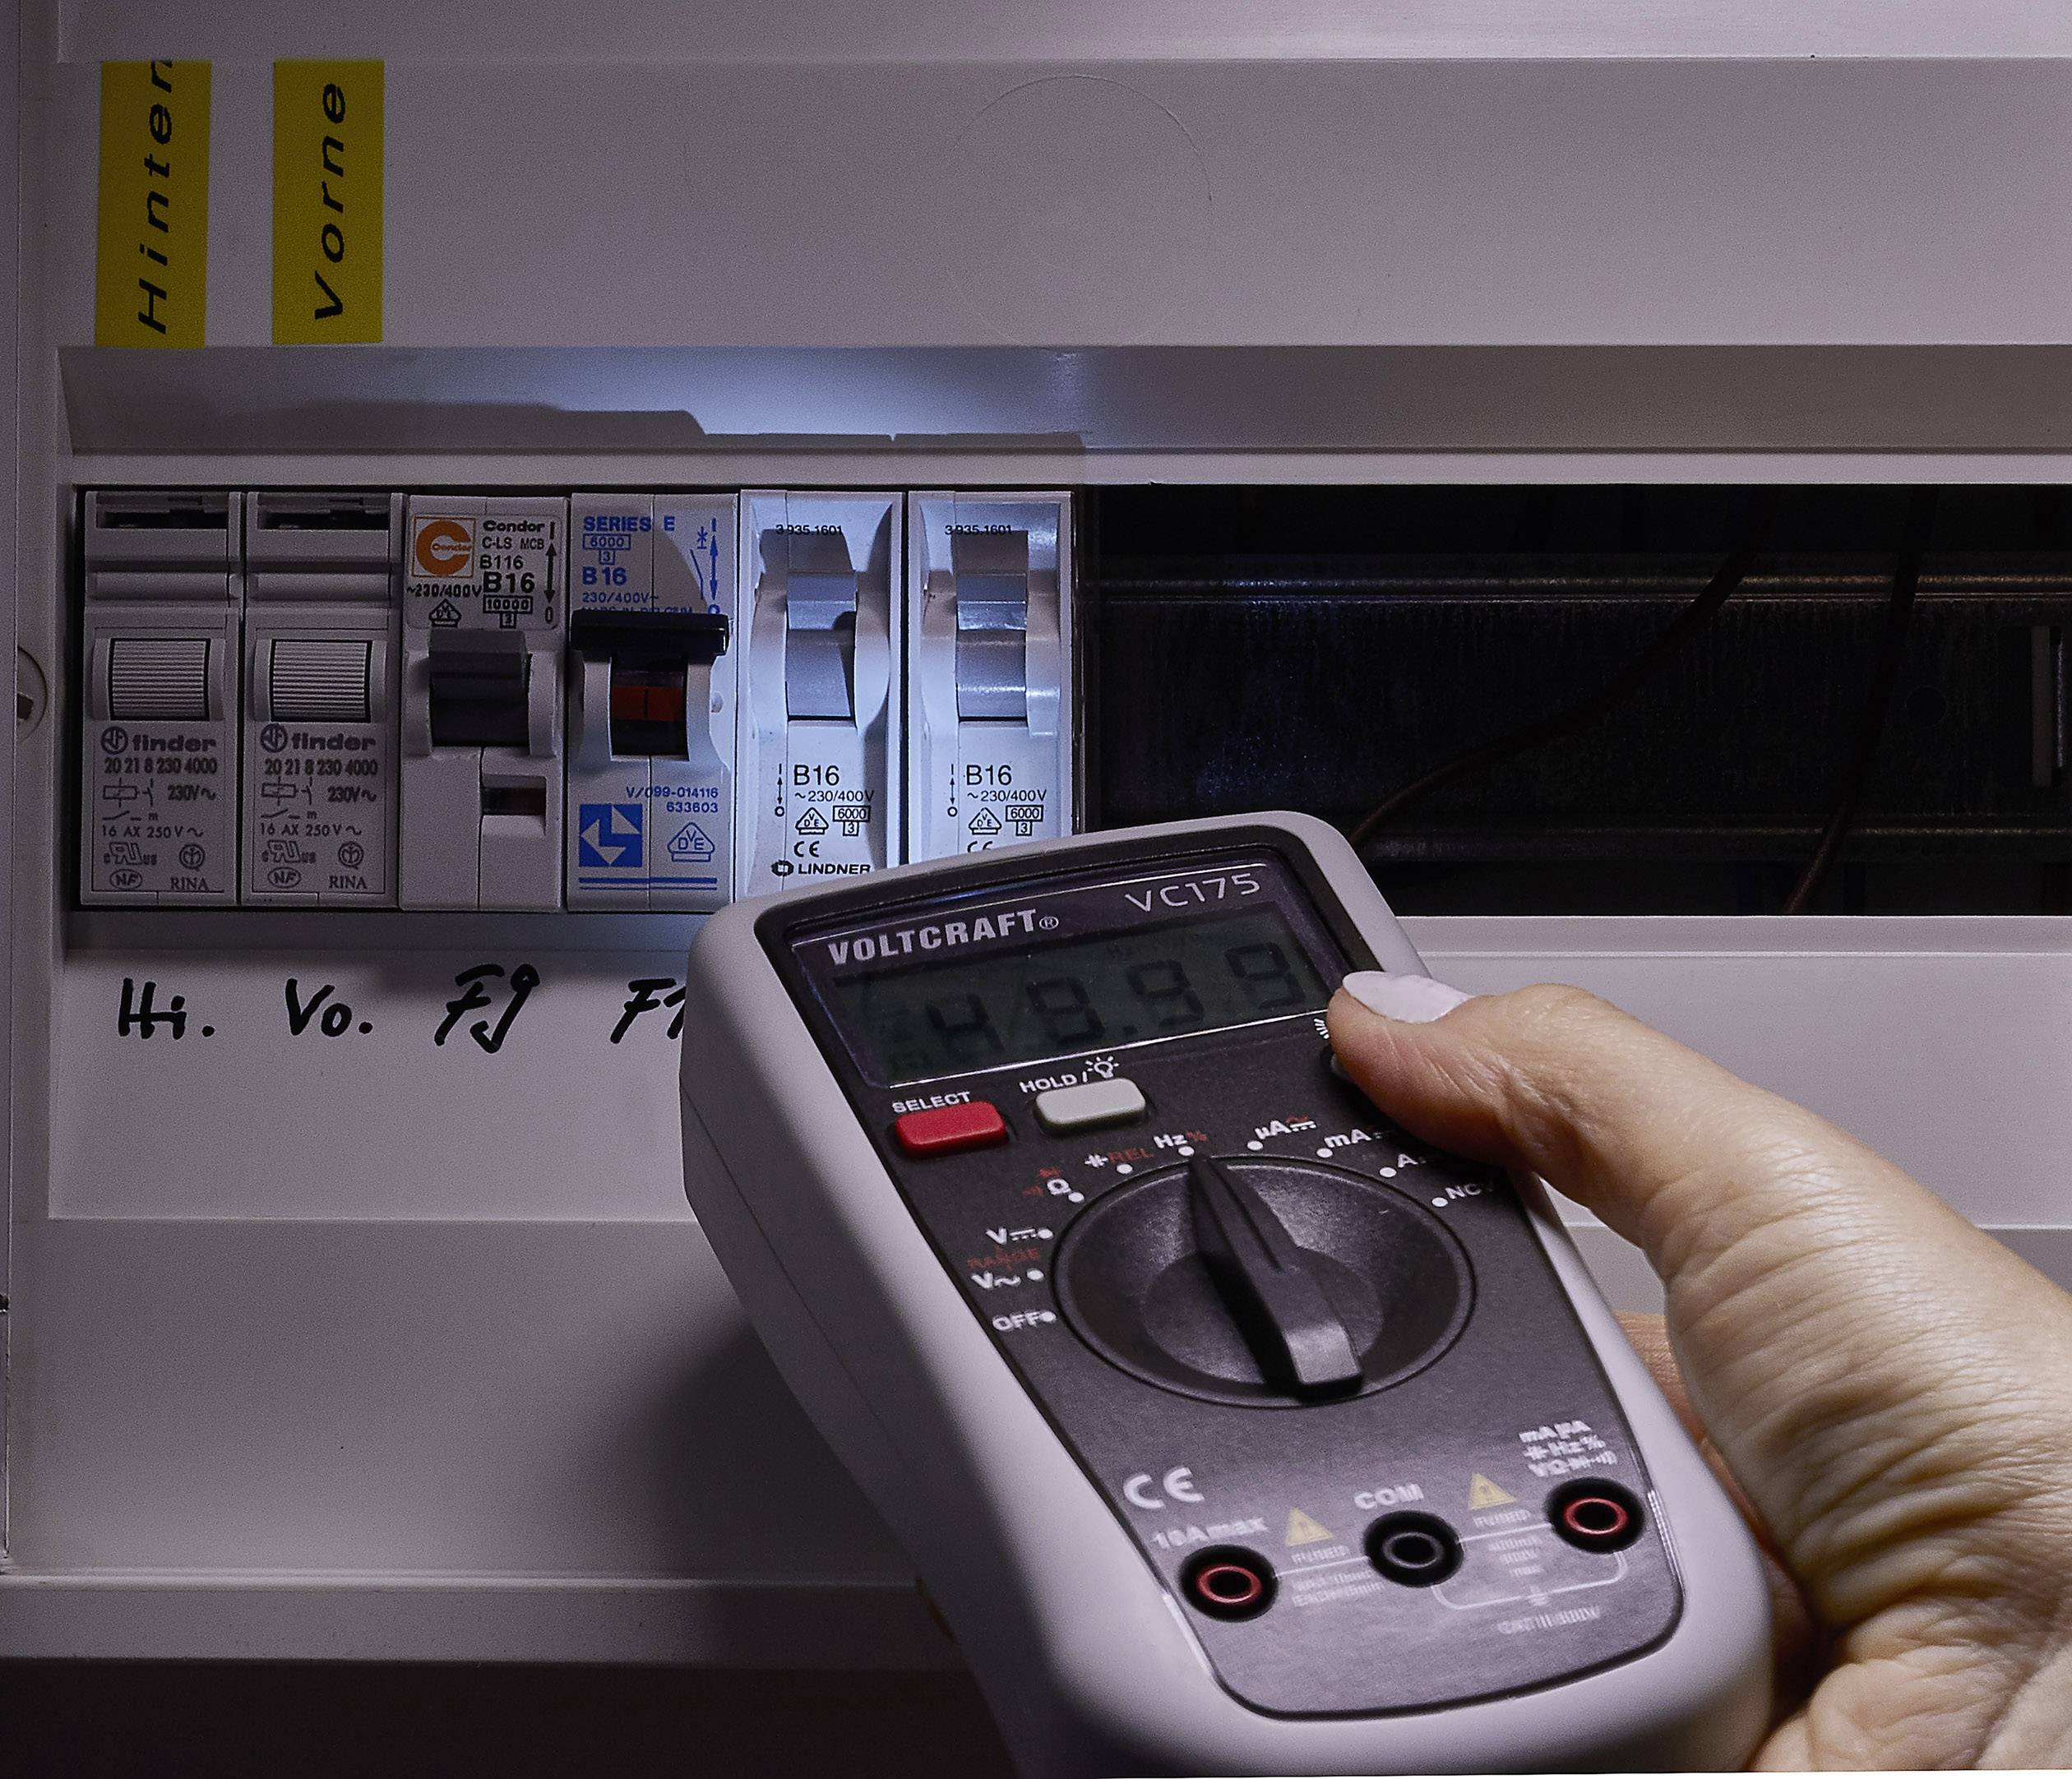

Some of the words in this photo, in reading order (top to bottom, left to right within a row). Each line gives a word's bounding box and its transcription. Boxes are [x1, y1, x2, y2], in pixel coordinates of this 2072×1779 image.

[314, 83, 345, 320] Vorne
[483, 520, 545, 533] Condor
[583, 515, 652, 532] SERIES
[664, 515, 675, 531] E
[520, 538, 545, 550] MCB
[589, 535, 625, 548] 6000
[480, 555, 524, 570] B116
[483, 571, 536, 594] B16
[485, 599, 530, 610] 10000
[132, 734, 217, 753] finder
[292, 732, 377, 751] finder
[793, 765, 839, 786] B16
[965, 765, 1012, 786] B16
[666, 802, 719, 813] 633603
[837, 807, 867, 820] 6000
[1011, 806, 1040, 820] 6000
[102, 825, 117, 837] 16
[146, 826, 172, 839] 250
[261, 824, 275, 835] 16
[306, 825, 330, 837] 250
[847, 823, 855, 834] 3
[1020, 822, 1029, 834] 3
[793, 840, 821, 857] CE
[798, 863, 872, 875] LINDNER
[115, 872, 140, 886] NF
[170, 876, 210, 890] RINA
[273, 871, 298, 885] NF
[329, 876, 368, 890] RINA
[1126, 873, 1261, 914] VC175
[284, 978, 374, 1039] Vo.
[892, 1091, 971, 1114] SELECT
[1153, 1134, 1188, 1148] Hz
[992, 1310, 1041, 1332] OFF
[1123, 1467, 1205, 1509] CE
[1354, 1482, 1425, 1510] COM
